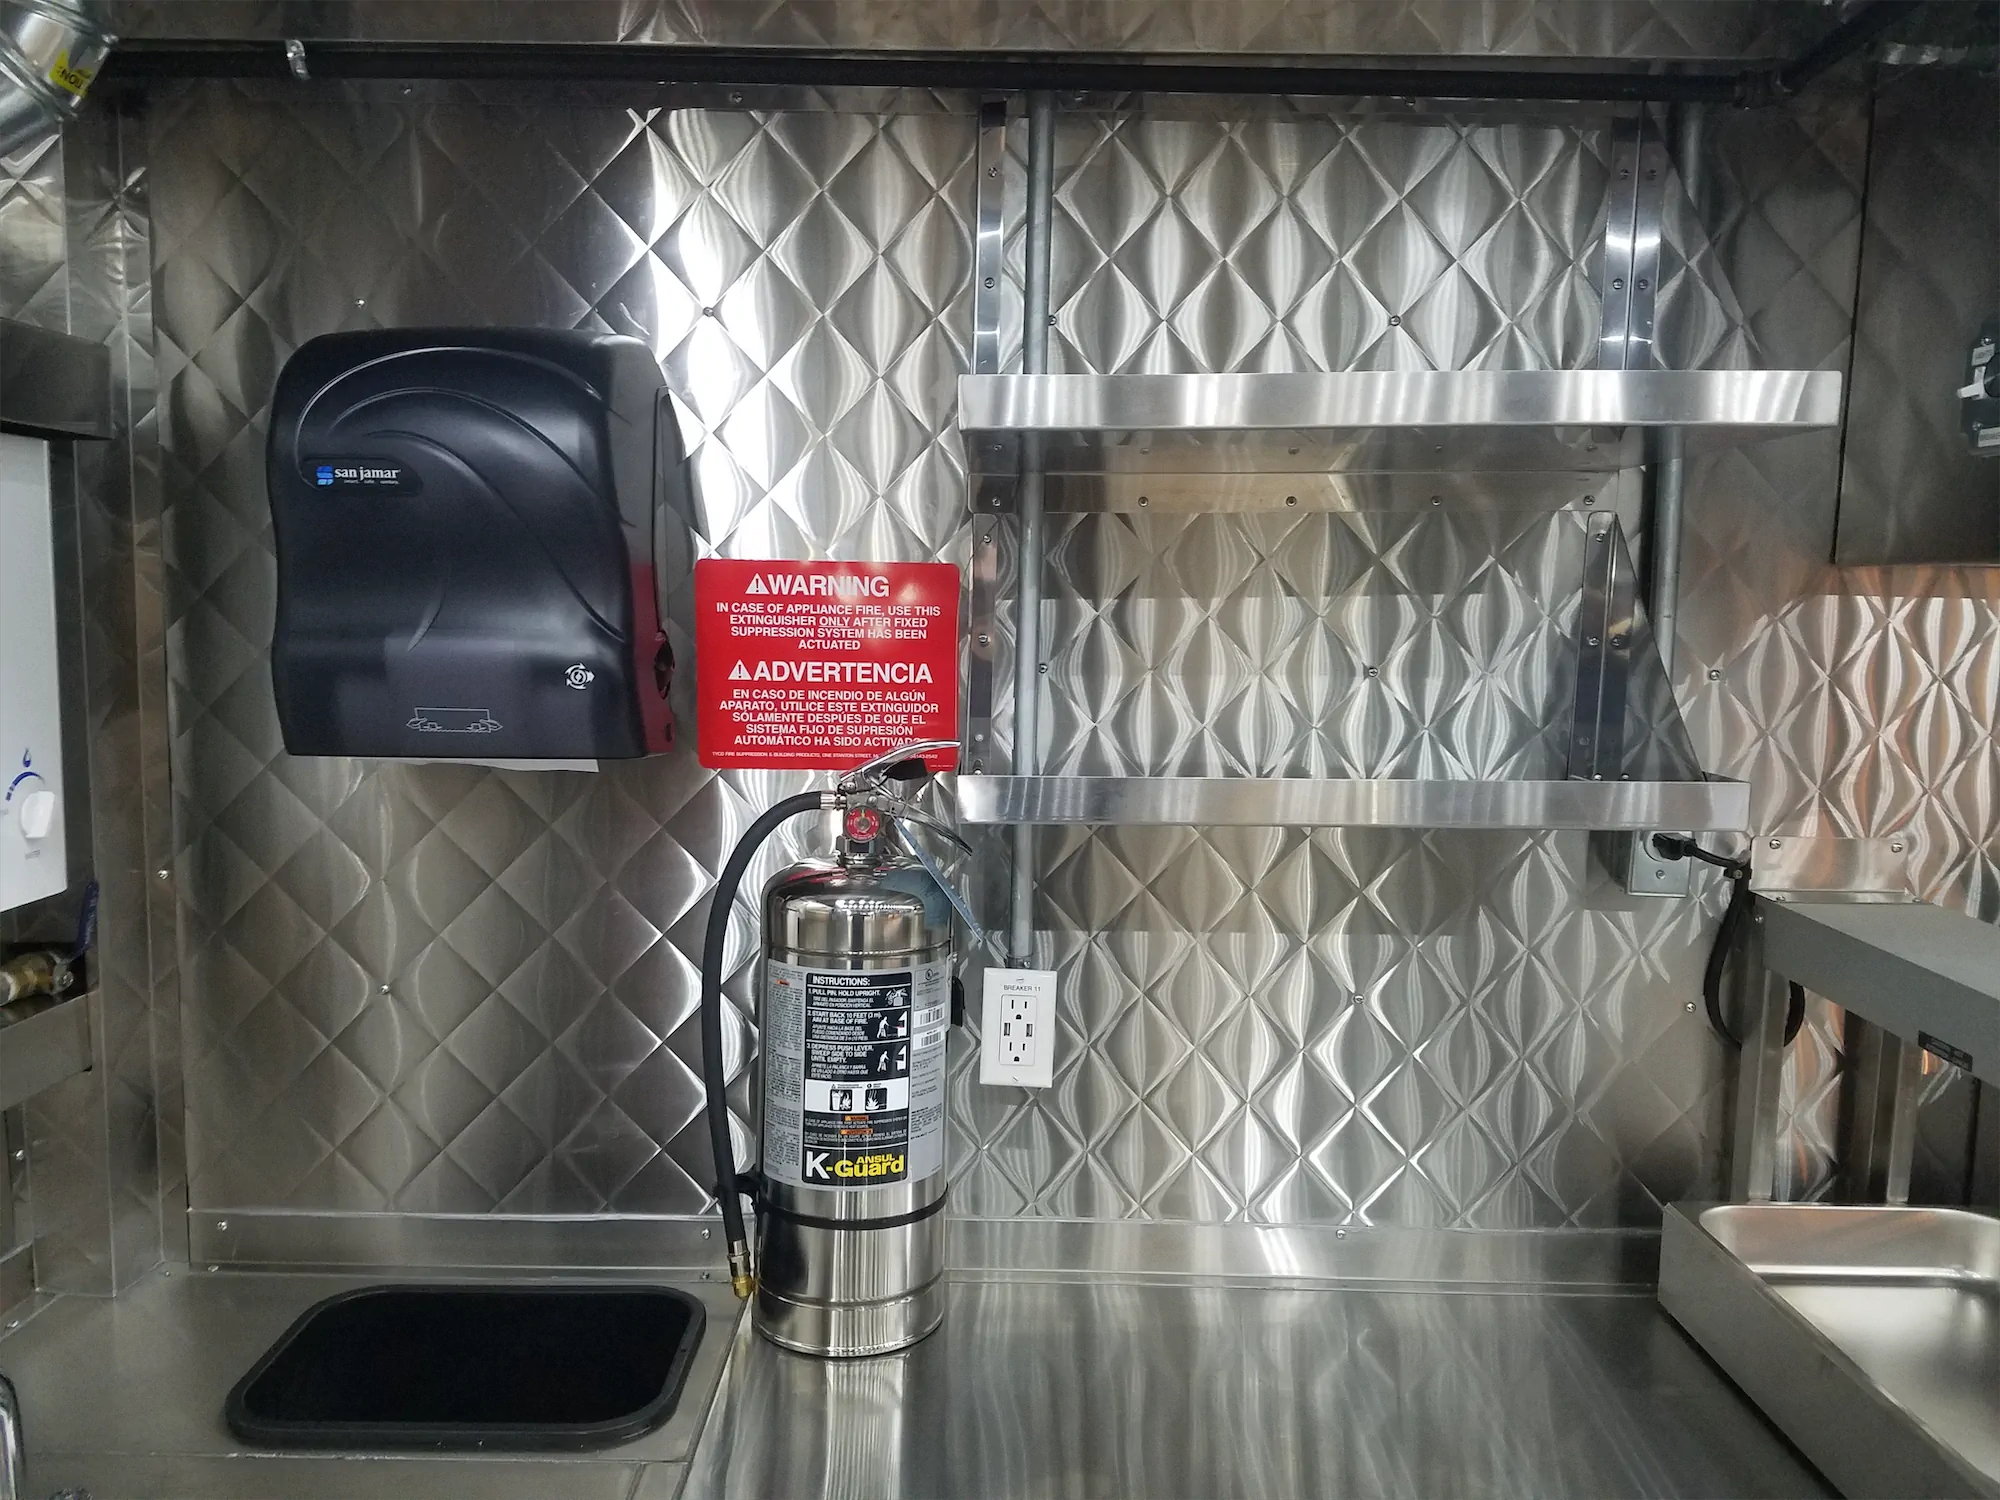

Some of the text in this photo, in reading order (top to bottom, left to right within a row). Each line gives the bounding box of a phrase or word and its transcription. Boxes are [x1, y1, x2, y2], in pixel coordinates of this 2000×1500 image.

[334, 466, 399, 480] san jamar
[767, 574, 889, 598] WARNING
[717, 602, 940, 616] IN CASE OF APPLIANCE FIRE, USE THIS
[730, 614, 928, 628] EXTINGUISHER ONLY AFTER FIXED
[731, 626, 927, 639] SUPPRESSION SYSTEM HAS BEEN
[798, 639, 860, 650] ACTUATED
[753, 661, 933, 683] ADVERTENCIA
[733, 688, 925, 701] EN CASO DE INCENDIO DE ALGÚN
[720, 701, 938, 713] APARATO, UTILICE ESTE EXTINGUIDOR
[733, 710, 926, 726] SÓLAMENTE DESPÚES DE QUE EL
[746, 723, 913, 736] SISTEMA FIJO DE SUPRESIÓN
[734, 734, 811, 746] AUTOMÁTICO
[814, 736, 831, 746] HA
[833, 736, 861, 746] SIDO
[812, 975, 870, 986] INSTRUCTIONS:
[806, 1150, 904, 1179] K-Guard
[856, 1153, 895, 1164] ANSUL
